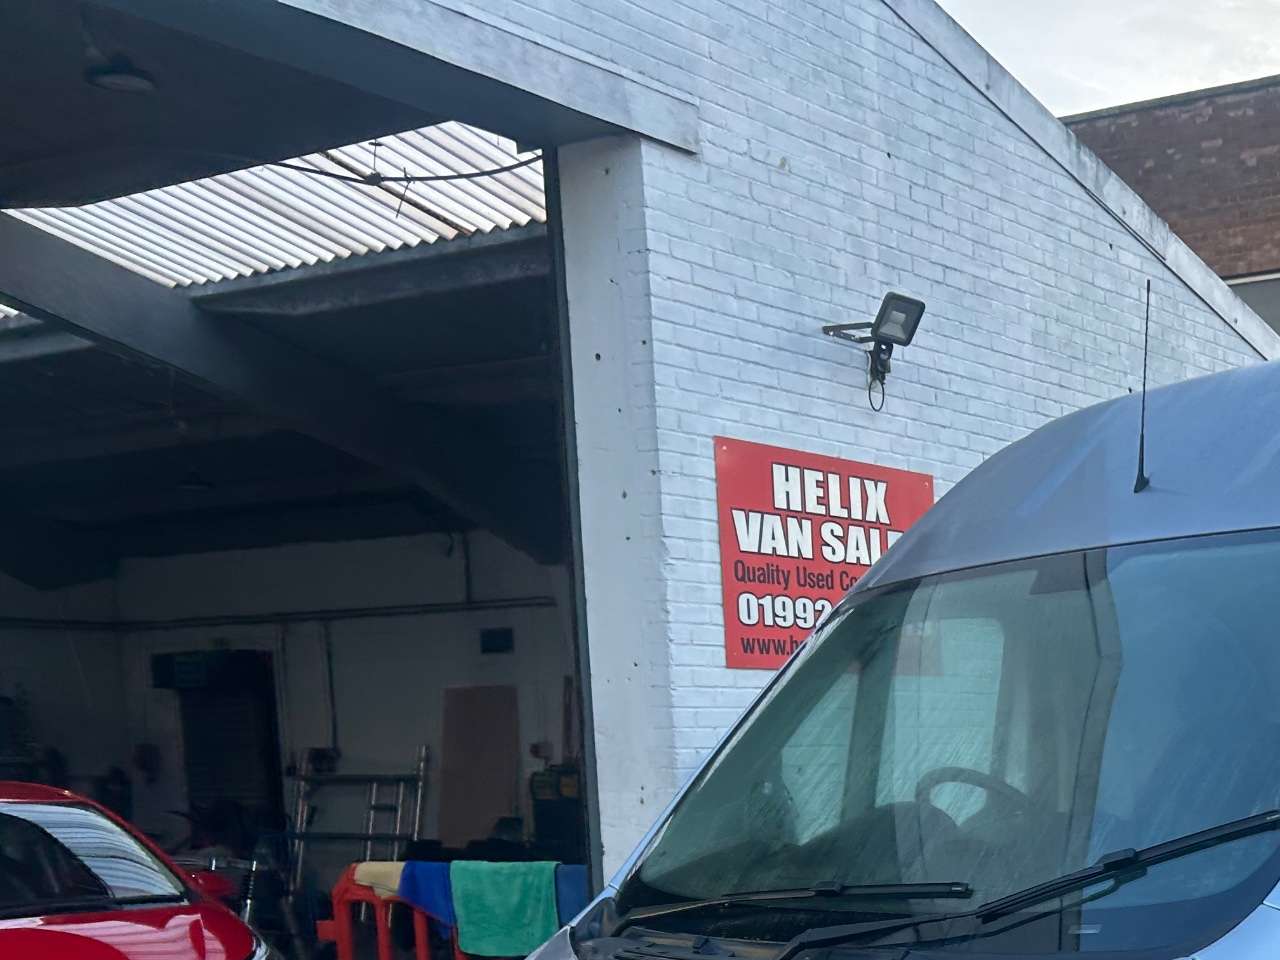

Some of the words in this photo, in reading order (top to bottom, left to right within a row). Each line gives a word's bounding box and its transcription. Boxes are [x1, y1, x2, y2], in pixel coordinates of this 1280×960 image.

[771, 462, 891, 525] HELIX
[731, 507, 814, 560] VAN
[734, 560, 790, 590] Quality
[796, 566, 834, 590] Used
[840, 571, 860, 592] Co
[737, 592, 834, 630] 01992
[741, 635, 804, 656] www.h
